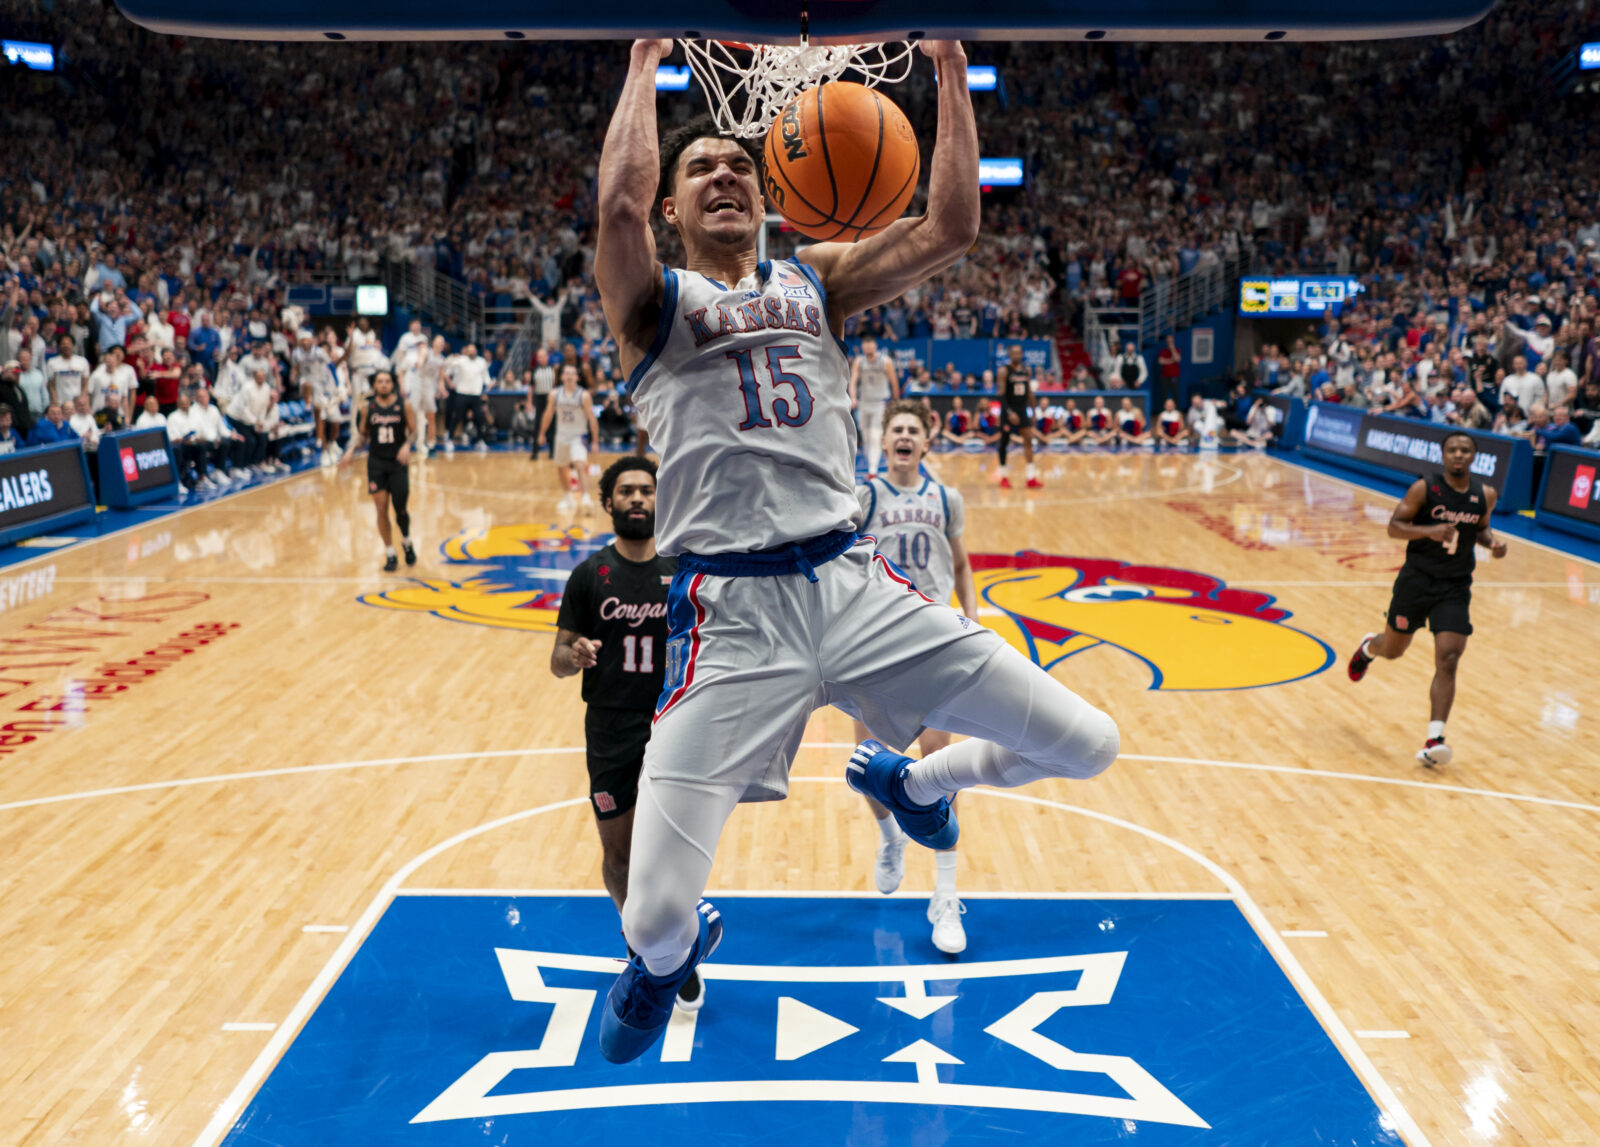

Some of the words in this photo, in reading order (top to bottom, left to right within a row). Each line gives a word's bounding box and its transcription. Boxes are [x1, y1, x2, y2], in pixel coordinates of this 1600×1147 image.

[684, 297, 822, 347] KANSAS
[726, 345, 816, 432] 15
[136, 448, 170, 471] TOYOTA
[879, 508, 942, 528] KANSAS
[1431, 505, 1481, 526] Cougars
[896, 531, 931, 570] 10
[622, 634, 654, 673] 11
